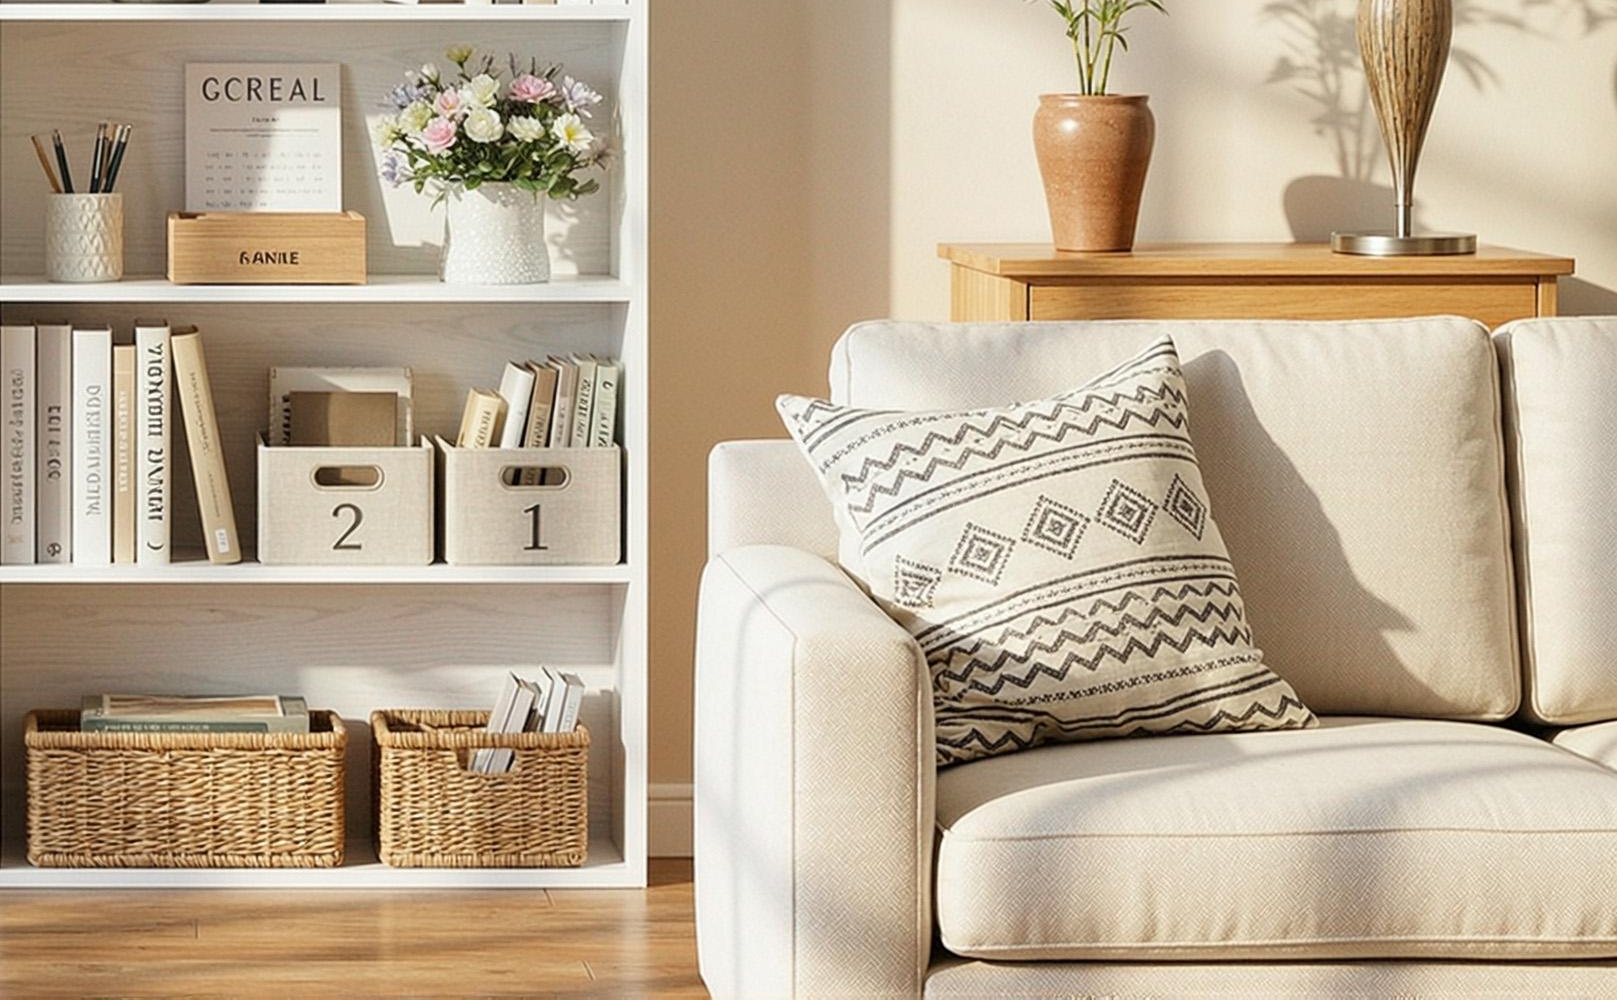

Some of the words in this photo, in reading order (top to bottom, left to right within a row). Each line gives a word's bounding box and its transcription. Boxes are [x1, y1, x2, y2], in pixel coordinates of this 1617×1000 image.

[202, 77, 325, 102] GCREAL
[332, 503, 364, 550] 2
[522, 504, 549, 550] 1
